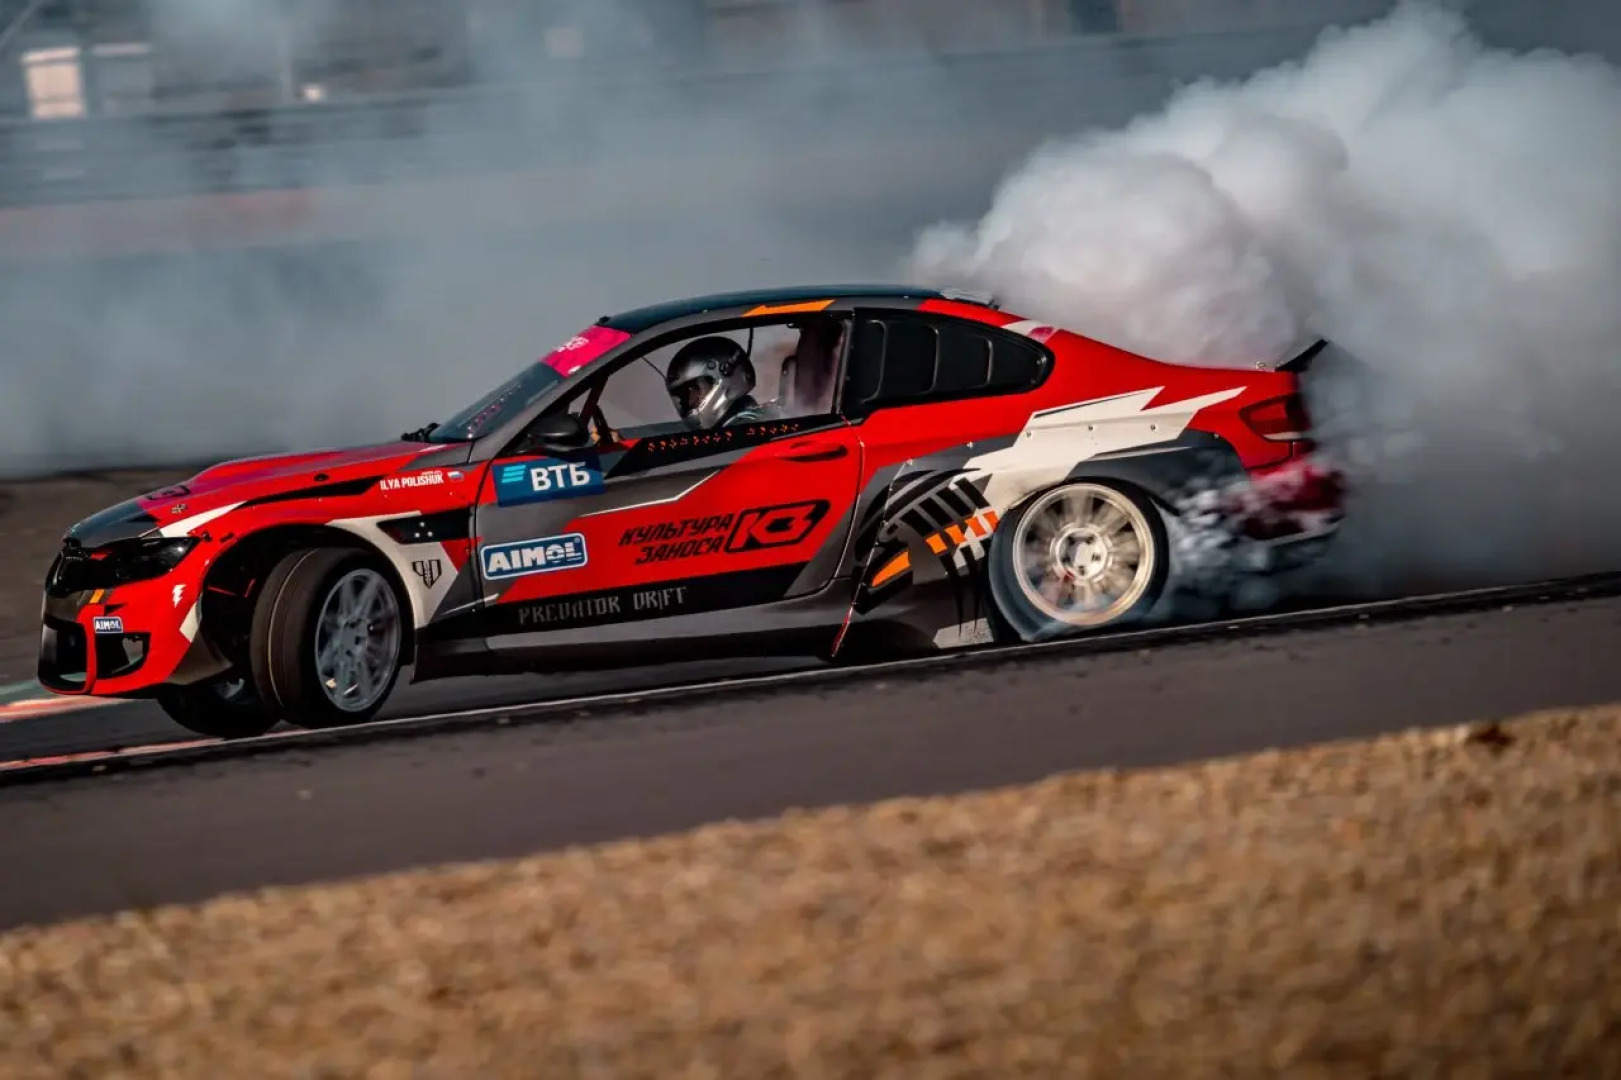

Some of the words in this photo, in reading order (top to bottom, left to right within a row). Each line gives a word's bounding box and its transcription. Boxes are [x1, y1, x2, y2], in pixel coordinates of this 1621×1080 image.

[380, 478, 401, 491] ILYA
[402, 473, 445, 488] POLISHUK
[530, 461, 591, 492] ВТБ
[618, 513, 745, 546] КУЛЬТУРА
[635, 536, 726, 565] ЗАНОСА
[518, 595, 622, 625] PREDATOR
[633, 586, 688, 610] DRIFT
